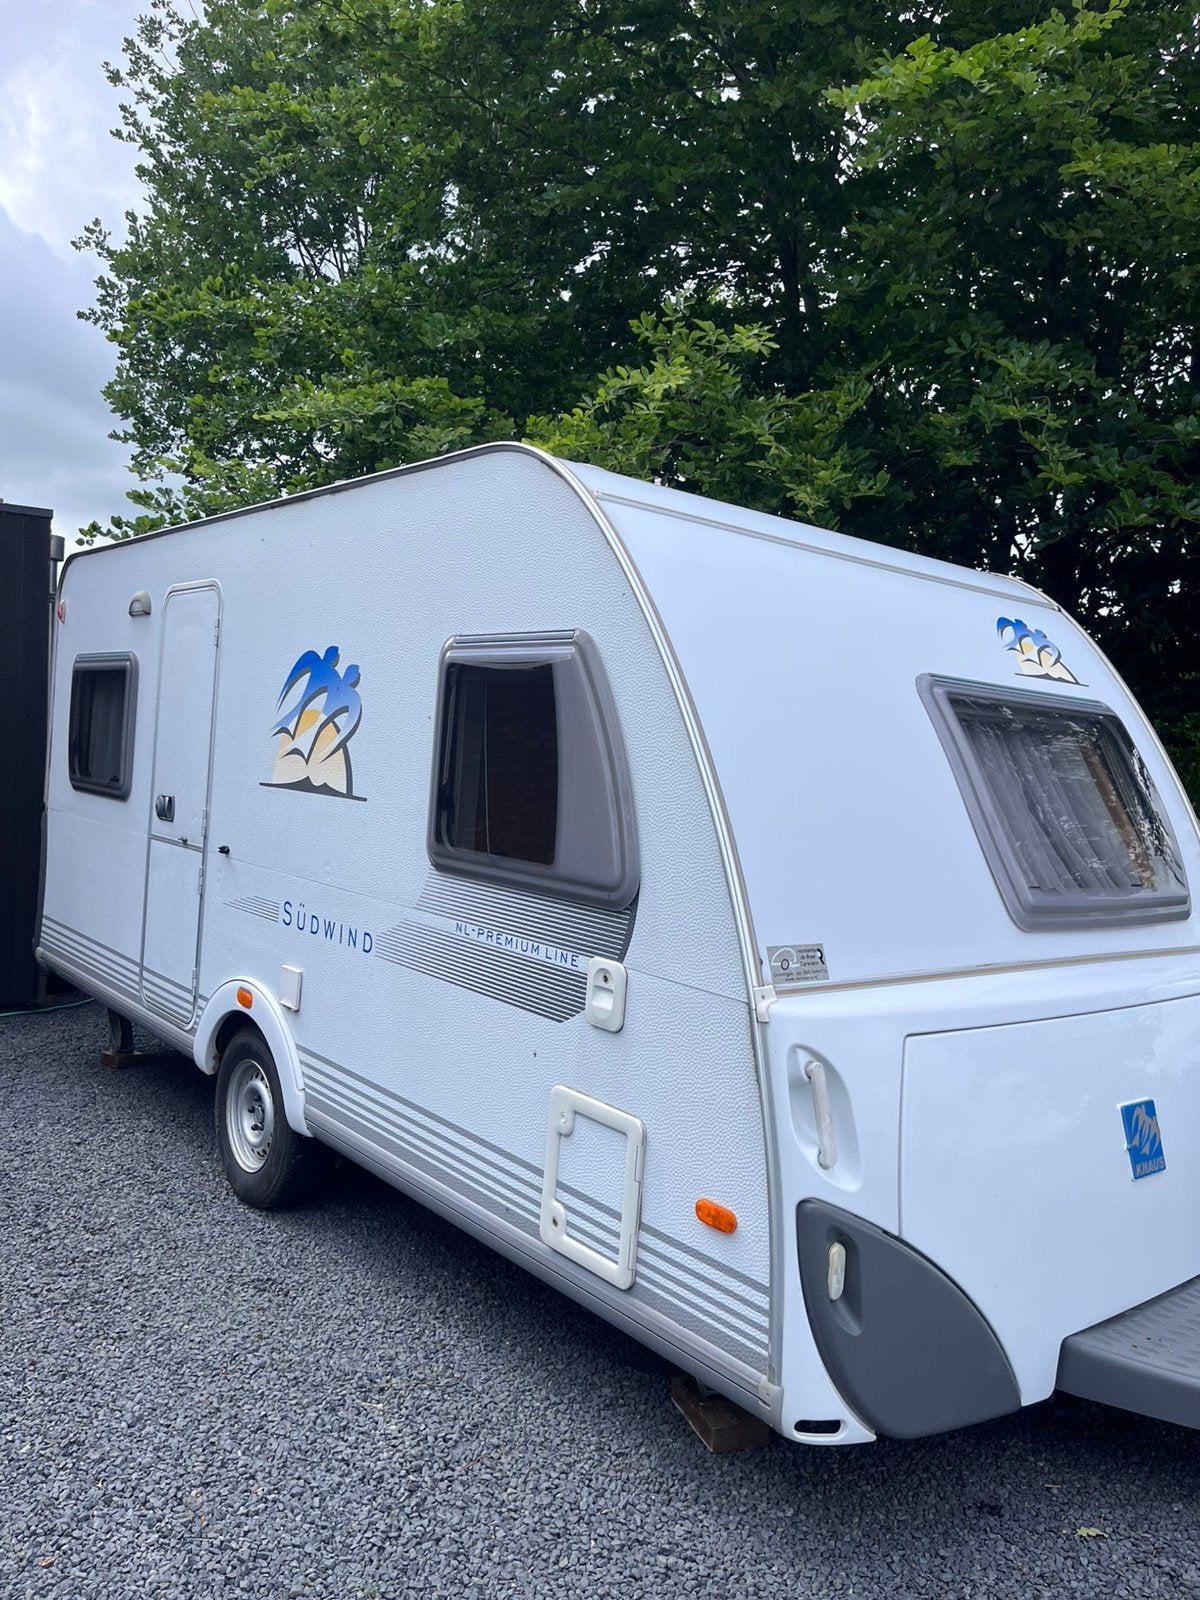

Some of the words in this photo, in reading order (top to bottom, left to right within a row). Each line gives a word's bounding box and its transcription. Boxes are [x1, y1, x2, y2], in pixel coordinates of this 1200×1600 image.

[282, 901, 373, 953] SÜDWIND
[455, 922, 540, 955] NL-PREMIUM
[545, 947, 579, 967] LINE
[1136, 1156, 1165, 1176] KNAUS
